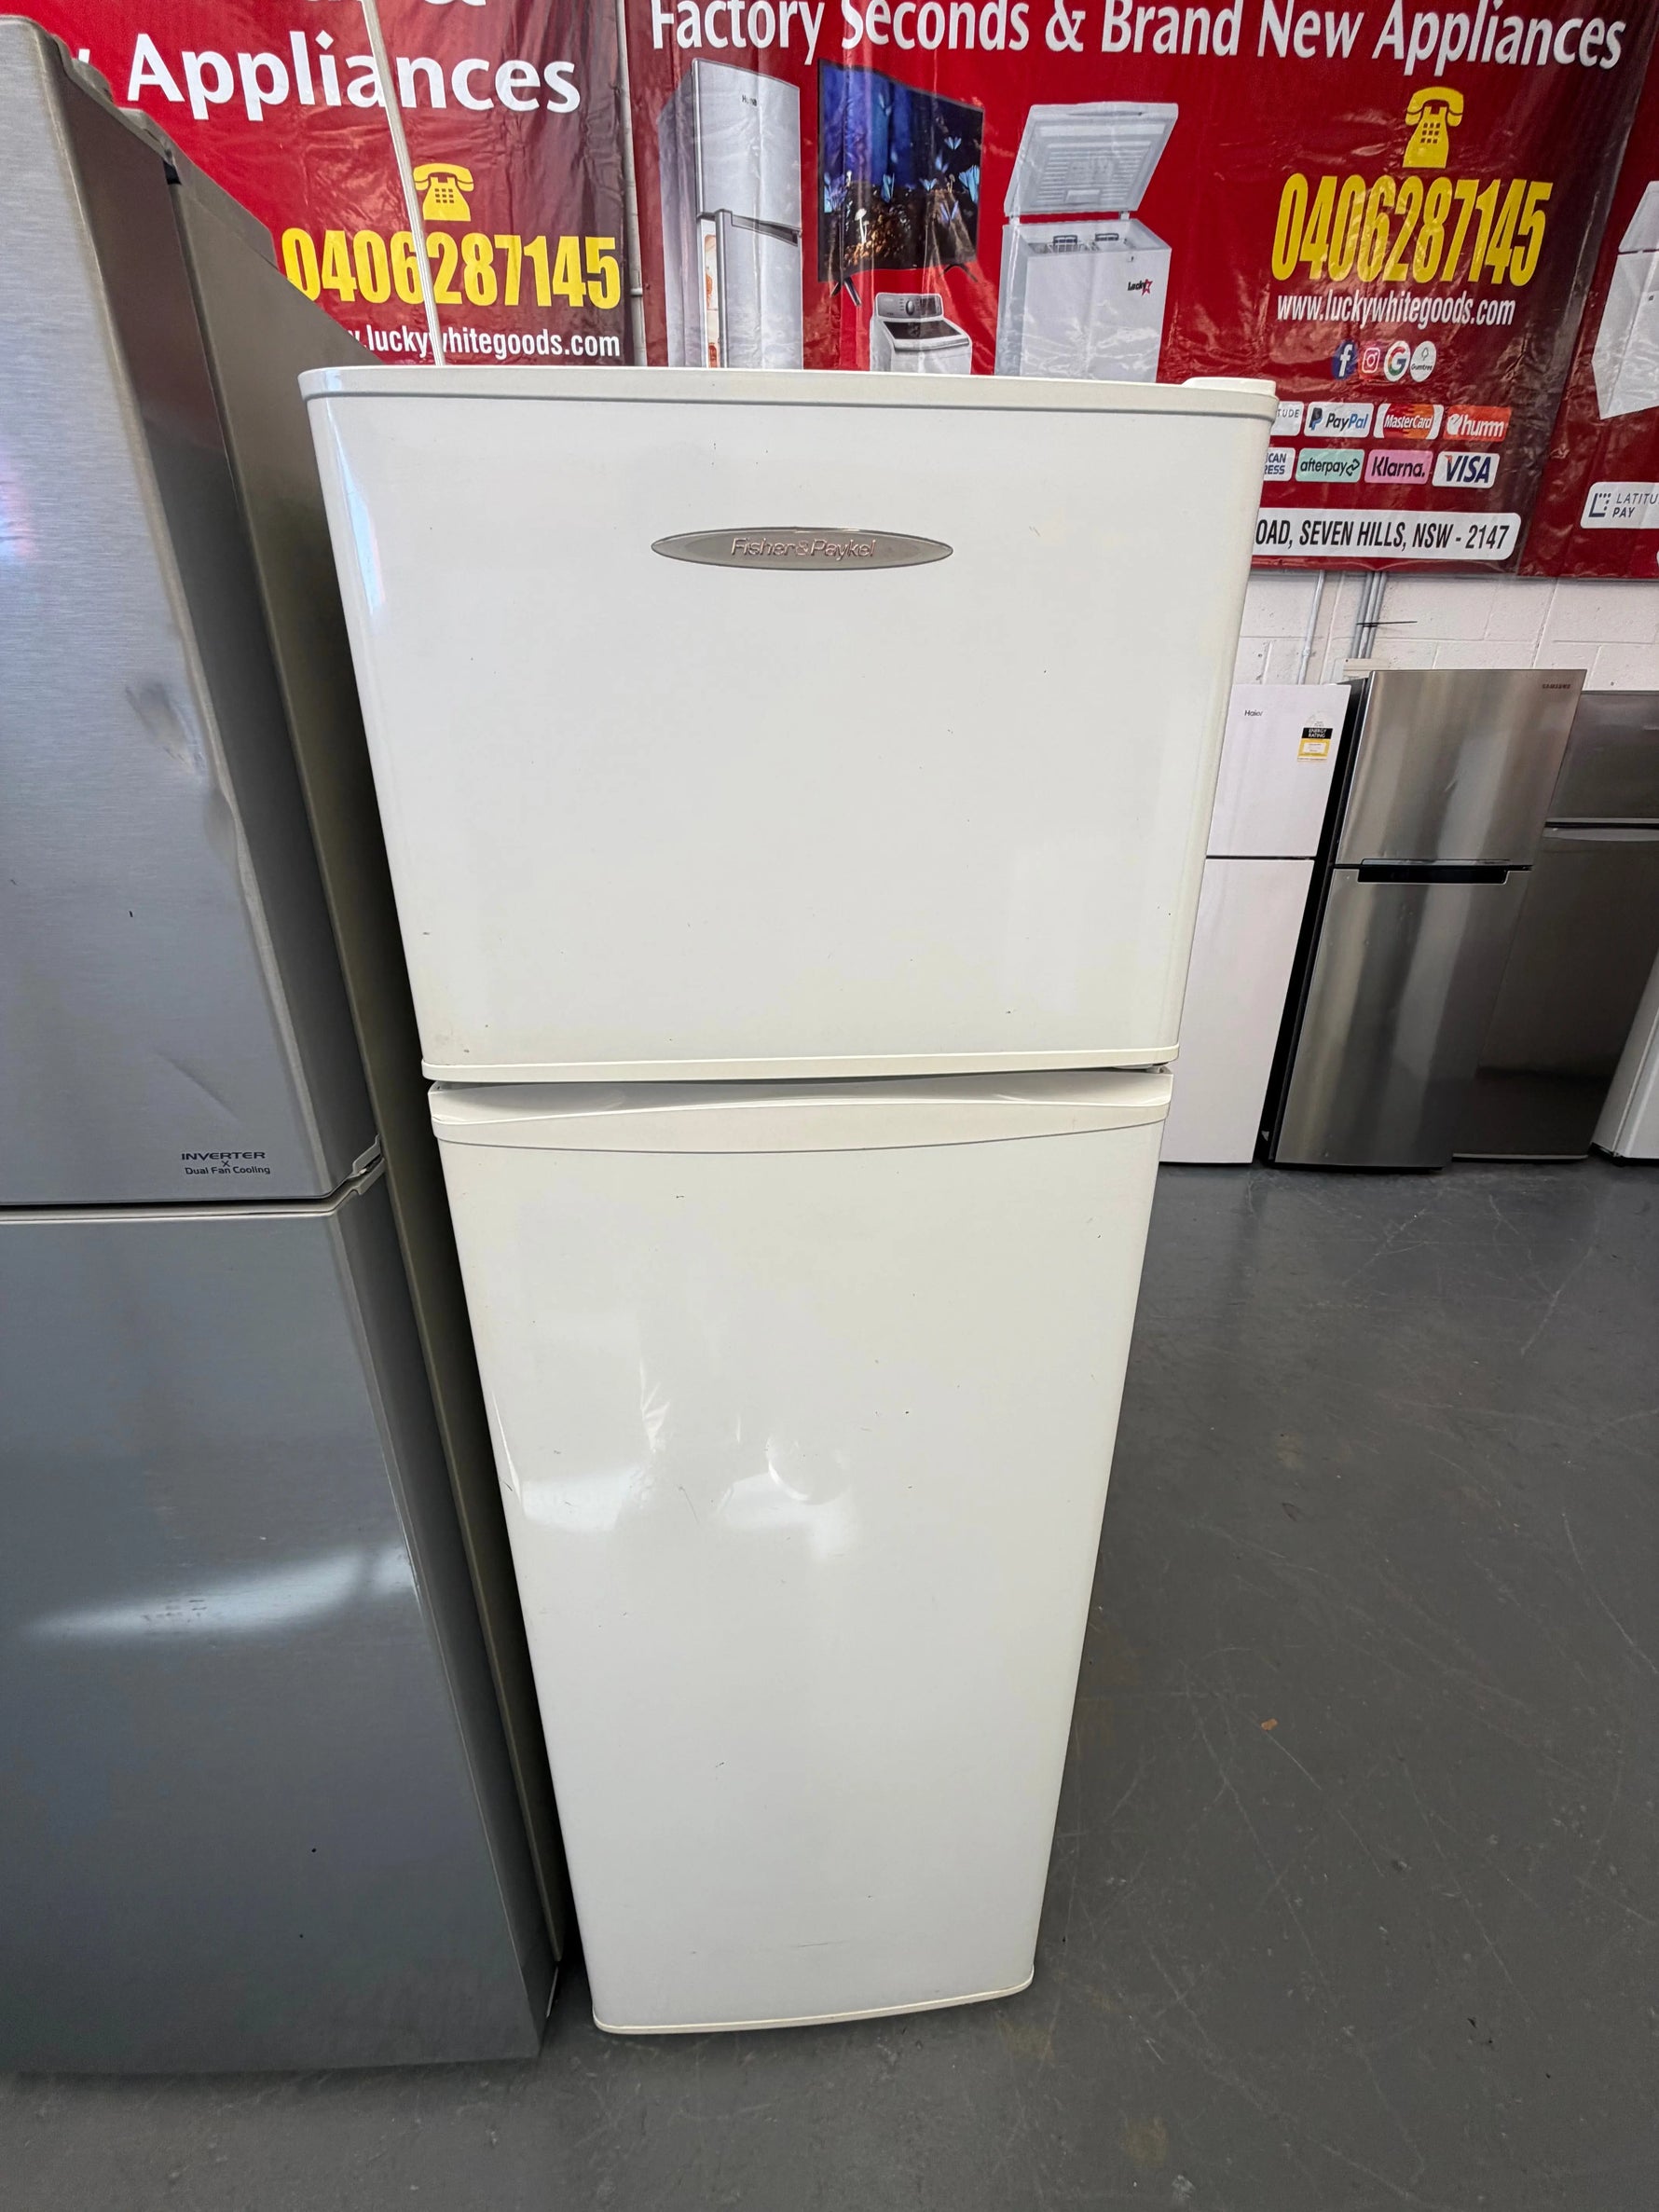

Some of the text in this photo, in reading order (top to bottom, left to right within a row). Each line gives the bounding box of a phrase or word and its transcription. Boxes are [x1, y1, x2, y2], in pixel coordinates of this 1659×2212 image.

[651, 0, 1627, 76] Factory Seconds & Brand New Appliances
[127, 30, 582, 121] Appliances
[1270, 172, 1554, 286] 0406287145
[281, 227, 621, 309] 0406287145
[1277, 288, 1516, 330] www.luckywhitegoods.com
[1325, 412, 1369, 432] PayPal
[1383, 414, 1433, 429] MasterCard
[1460, 414, 1505, 438] humm
[1300, 458, 1348, 476] afterpay
[1371, 456, 1425, 478] Klarna.
[1445, 454, 1492, 484] VISA
[1616, 492, 1659, 505] LATITU
[1612, 506, 1635, 518] PAY
[1299, 519, 1354, 546] SEVEN
[1356, 521, 1407, 552] HILLS,
[1412, 522, 1454, 549] NSW
[1465, 524, 1511, 550] 2147
[181, 1151, 266, 1161] INVERTER
[232, 1166, 271, 1175] Cooling
